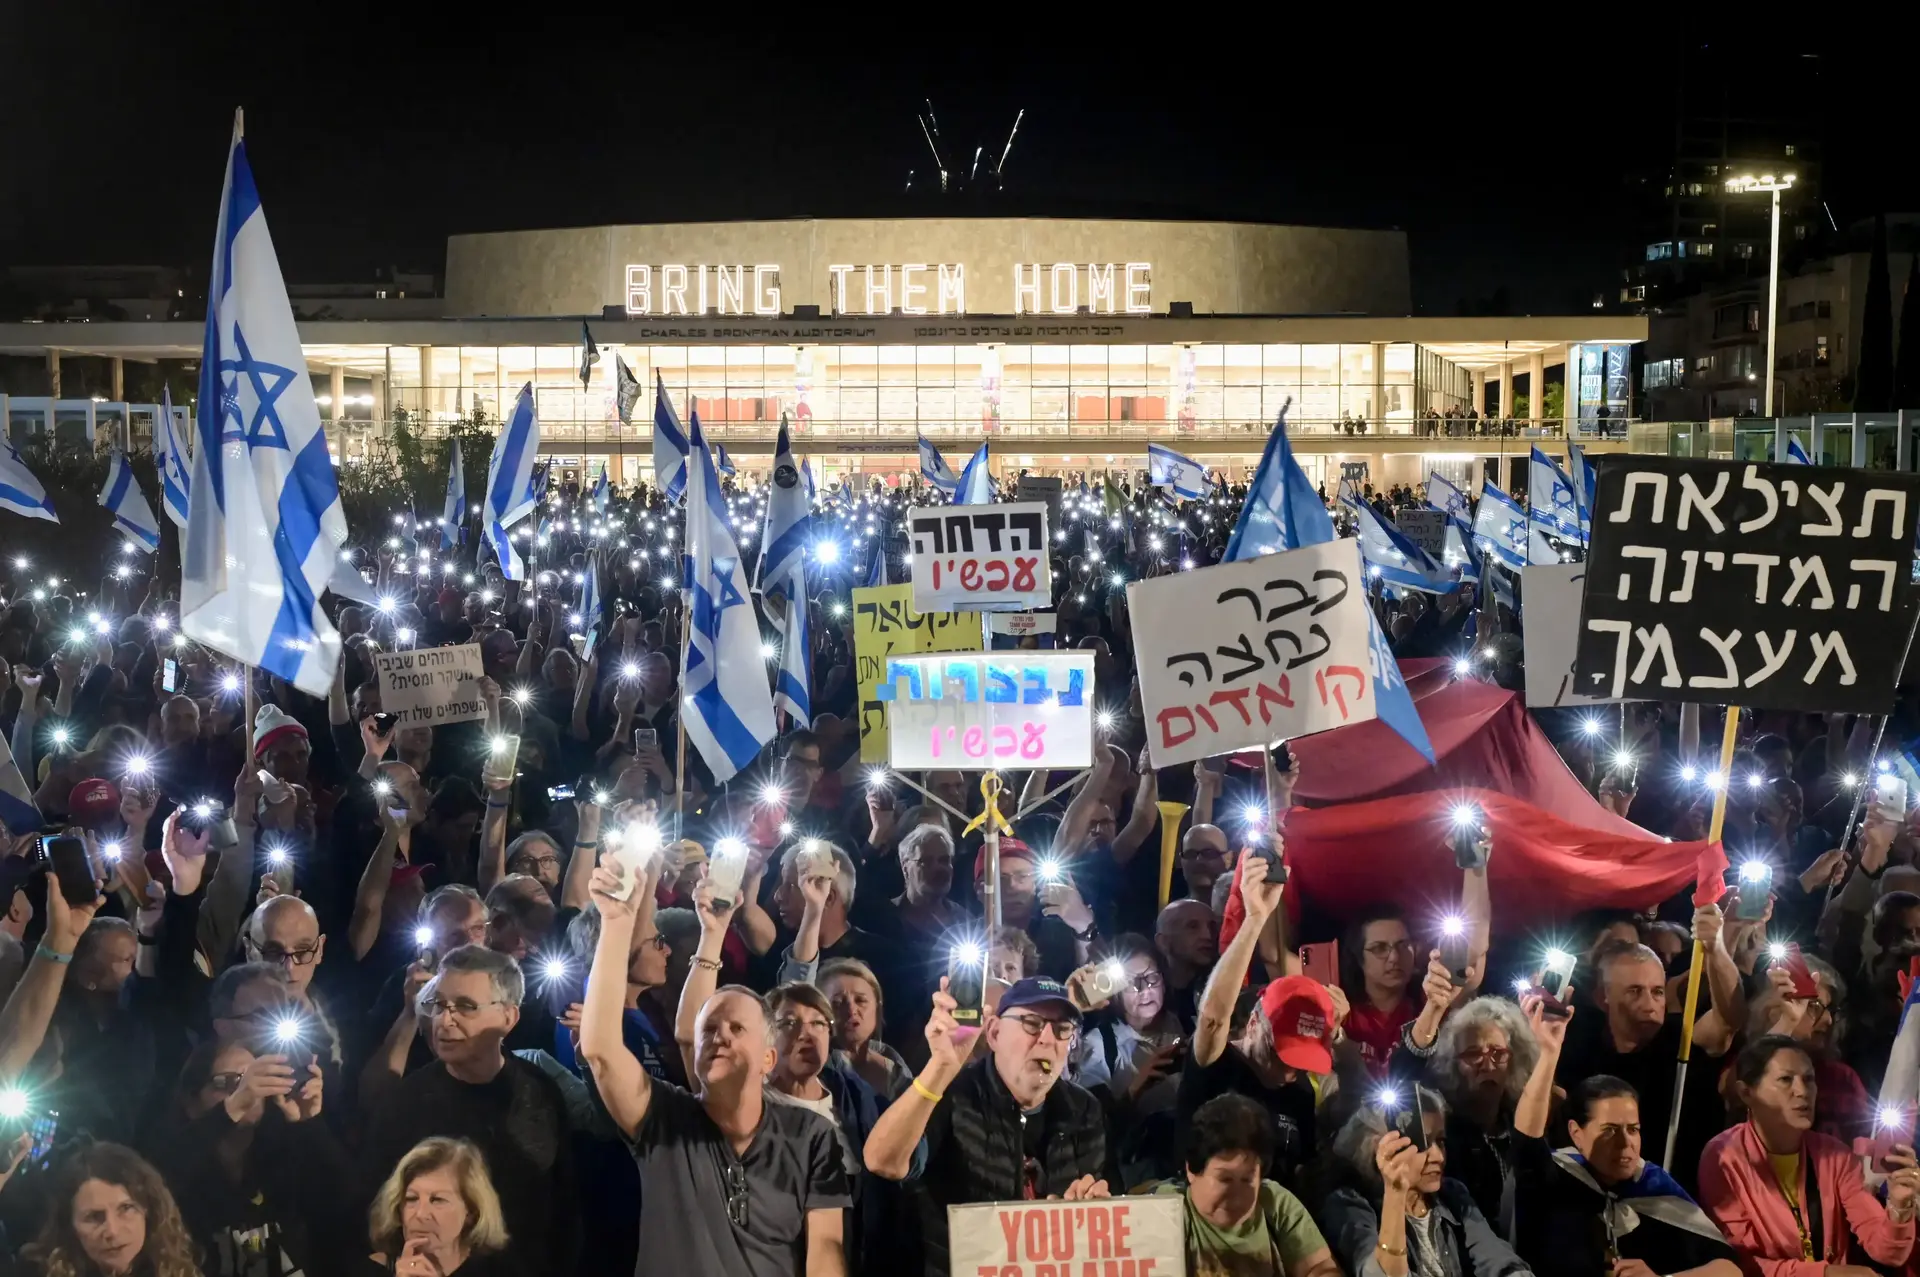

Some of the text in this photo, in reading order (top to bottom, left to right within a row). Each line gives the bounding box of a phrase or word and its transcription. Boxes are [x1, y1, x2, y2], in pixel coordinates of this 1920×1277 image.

[625, 262, 1152, 315] BRING THEM HOME
[641, 328, 875, 338] CHARLES BRONFMAN AUDITORIUM
[1037, 326, 1089, 336] התרבות
[1091, 326, 1124, 336] היכל
[1609, 351, 1628, 381] JAZZ
[912, 512, 1043, 554] הדחה
[932, 556, 1039, 593] עכשיו
[1617, 544, 1897, 612] המדינה
[1216, 569, 1349, 624] כבר
[378, 647, 481, 672] איך מזהים שביבי
[1166, 623, 1332, 688] נחצה
[389, 672, 434, 690] ומסית?
[876, 660, 1085, 707] נבצרות
[412, 704, 433, 721] שלו
[437, 700, 487, 718] השפתיים
[1155, 665, 1366, 750] קו אדום
[931, 721, 1048, 761] עכשיו
[999, 1206, 1133, 1263] YOU'RE
